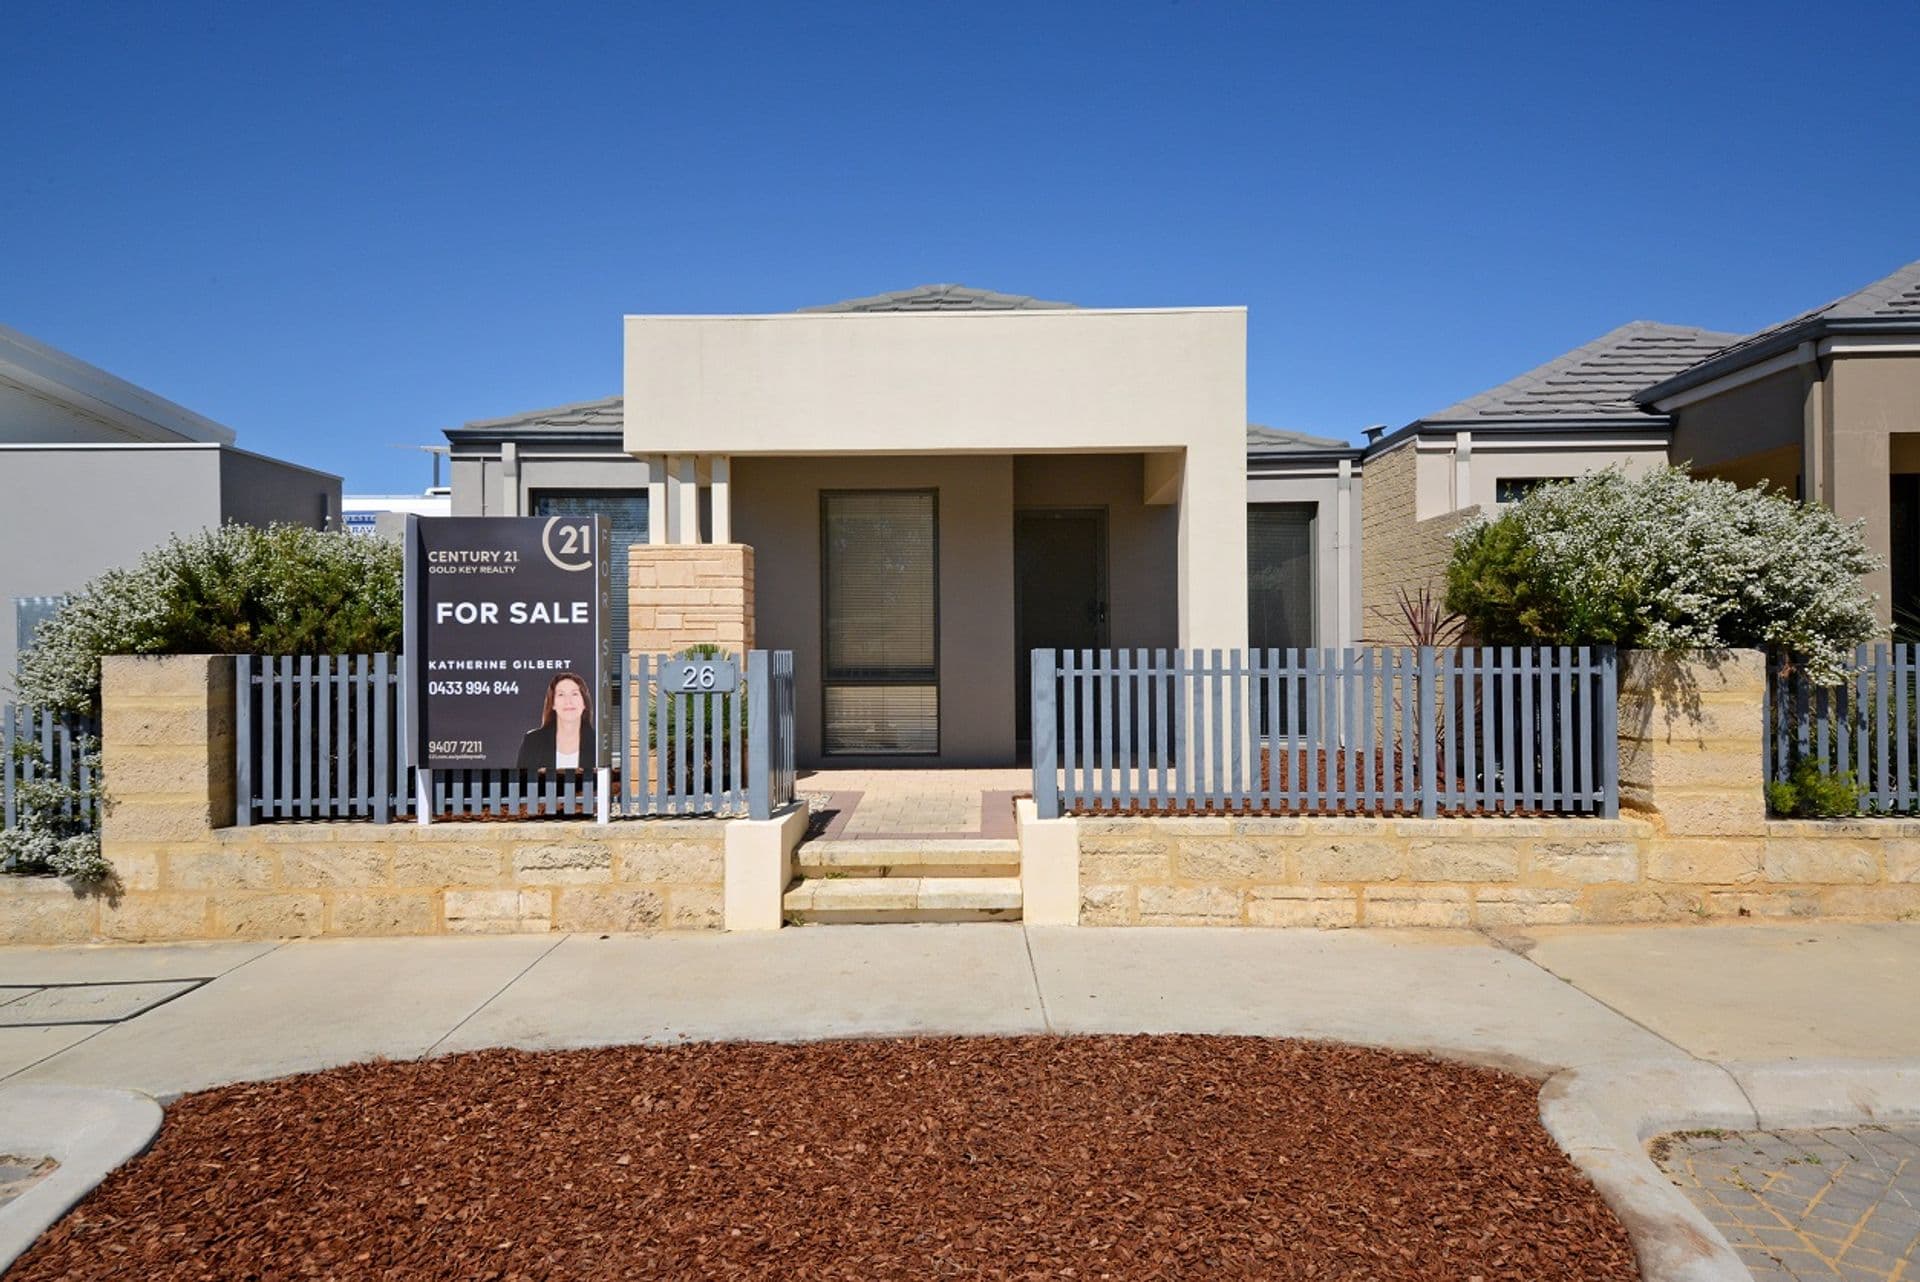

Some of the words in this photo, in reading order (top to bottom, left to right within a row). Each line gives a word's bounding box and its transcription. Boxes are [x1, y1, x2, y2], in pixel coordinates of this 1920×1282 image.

[428, 551, 500, 562] CENTURY
[428, 565, 456, 574] GOLD
[458, 565, 479, 574] KEY
[480, 565, 516, 574] REALTY
[601, 529, 609, 608] FOR
[437, 602, 499, 624] FOR
[509, 602, 589, 624] SALE
[428, 660, 507, 670] KATHERINE
[512, 660, 572, 669] GILBERT
[683, 665, 715, 688] 26
[429, 681, 462, 695] 0433
[465, 681, 490, 695] 994
[493, 681, 519, 695] 844
[602, 638, 610, 750] SALE
[428, 740, 458, 753] 9407
[459, 740, 482, 753] 7211
